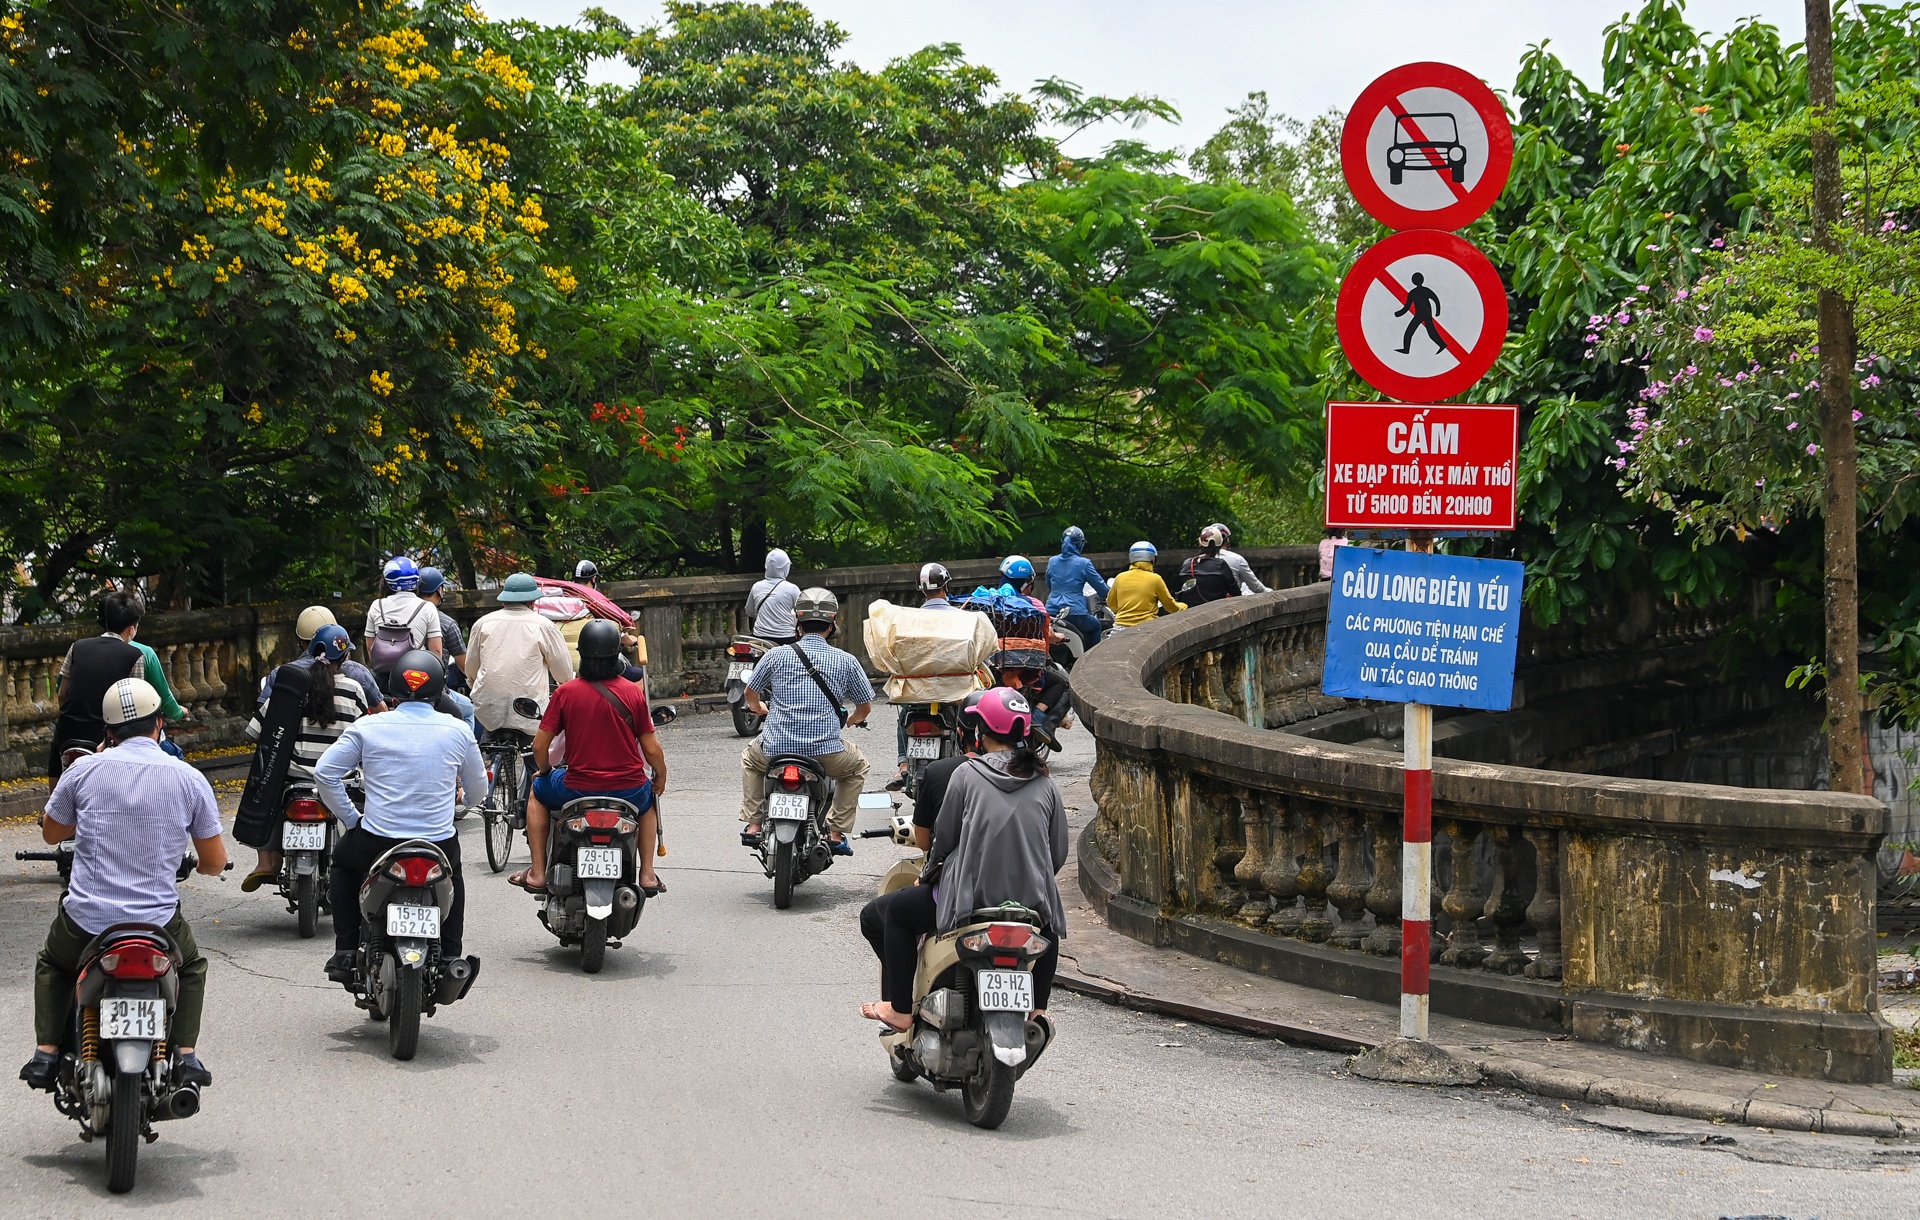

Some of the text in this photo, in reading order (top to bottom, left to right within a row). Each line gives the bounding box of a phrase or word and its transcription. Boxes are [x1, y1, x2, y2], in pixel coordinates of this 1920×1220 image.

[1387, 410, 1459, 454] CẤM
[1334, 464, 1353, 483] XE
[1357, 464, 1387, 487] ĐẠP
[1425, 465, 1444, 485] XE
[1447, 462, 1479, 486] MÁY
[1346, 489, 1492, 515] TỪ 5H00 ĐẾN 20H00
[1342, 563, 1509, 611] CẦU LONG BIÊN YẾU
[1345, 613, 1506, 644] CÁC PHƯƠNG TIỆN HẠN CHẾ
[1365, 639, 1478, 666] QUA CẦU ĐỂ TRÁNH
[1360, 661, 1478, 691] ÙN TẮC GIAO THÔNG
[909, 748, 937, 758] 269.41
[776, 796, 803, 807] 29-E2
[771, 806, 805, 818] 030.10
[290, 824, 319, 835] 29-C1
[286, 836, 321, 848] 224.90
[584, 850, 615, 863] 29-C1
[581, 863, 619, 877] 784.53
[396, 907, 432, 922] 15-B2
[391, 921, 437, 936] 052.43
[986, 974, 1025, 990] 29-H2
[983, 992, 1030, 1009] 008.45
